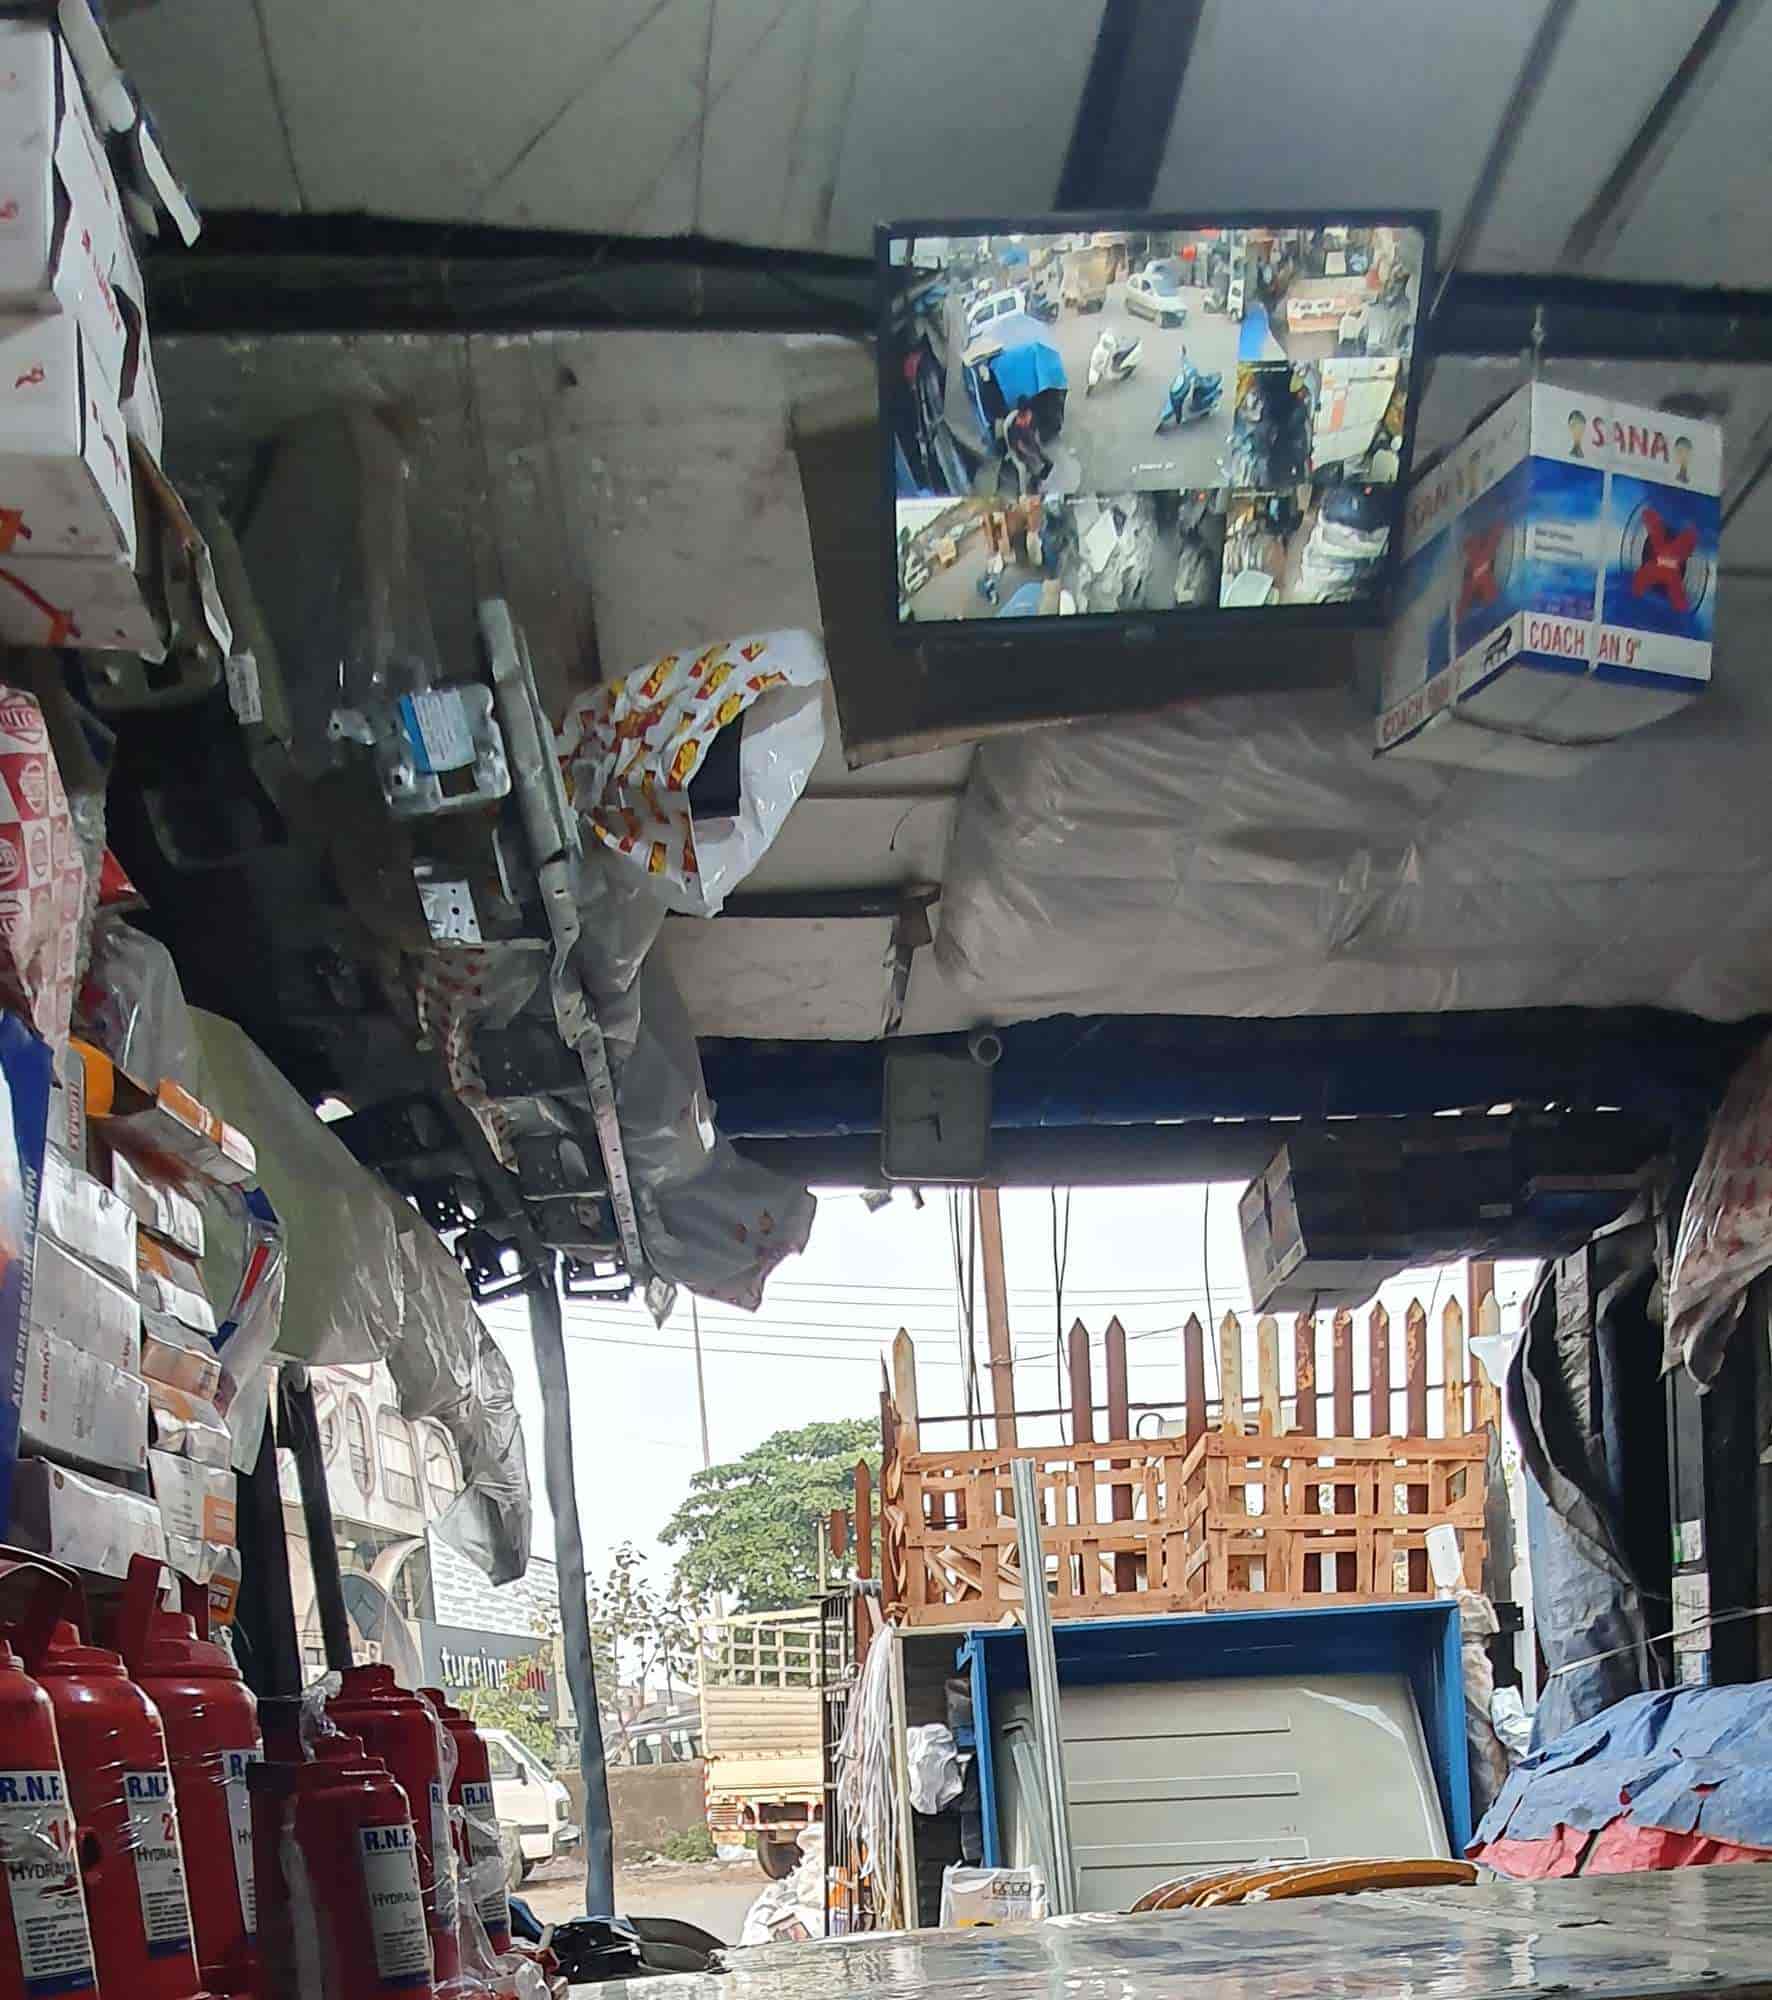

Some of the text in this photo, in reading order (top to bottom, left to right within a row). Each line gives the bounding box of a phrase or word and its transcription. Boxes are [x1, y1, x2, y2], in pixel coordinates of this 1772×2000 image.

[1591, 416, 1669, 463] SANA
[1529, 620, 1584, 657] COACH
[1597, 633, 1621, 661] AN
[9, 1367, 25, 1409] AIR
[23, 1165, 39, 1234] HORN
